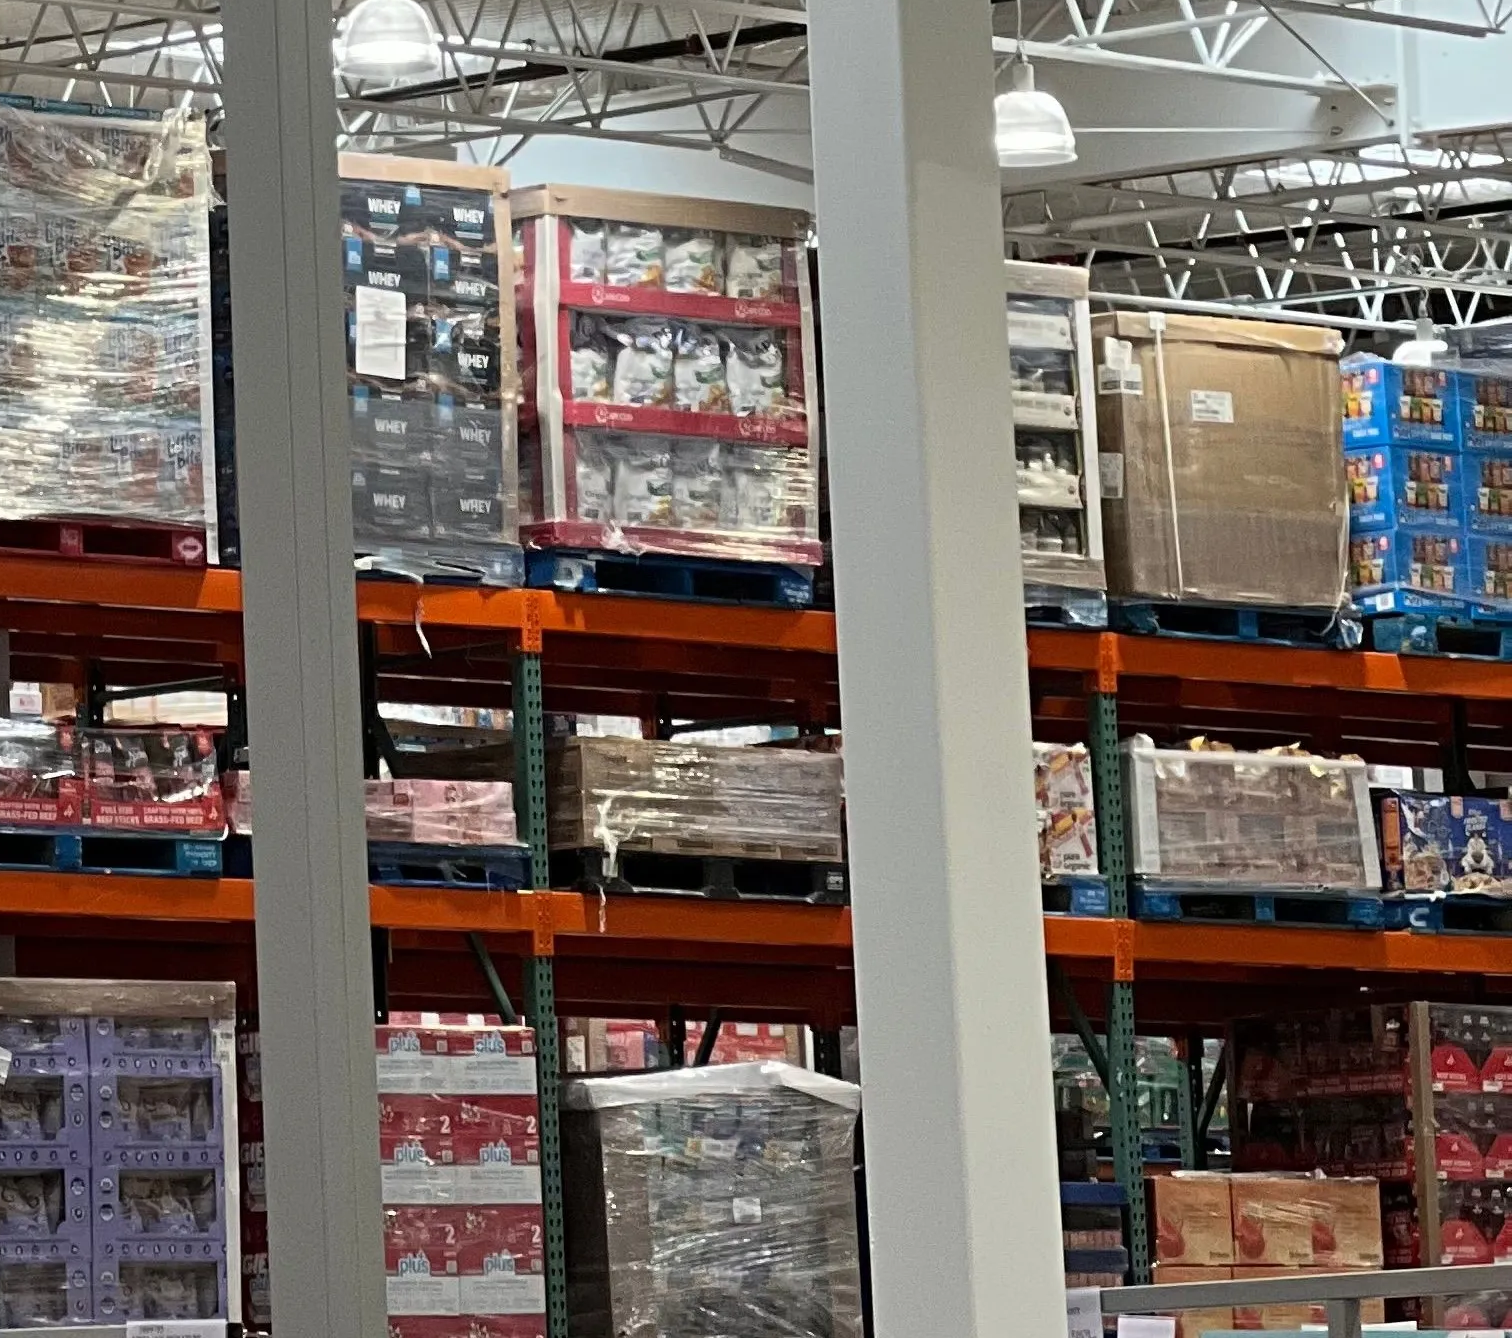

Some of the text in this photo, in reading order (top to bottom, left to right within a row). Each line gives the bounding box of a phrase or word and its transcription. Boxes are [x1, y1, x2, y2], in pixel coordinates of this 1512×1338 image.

[368, 198, 401, 215] WHEY
[452, 207, 485, 224] WHEY
[368, 270, 401, 287] WHEY
[455, 280, 487, 297] WHEY
[457, 352, 489, 369] WHEY
[374, 418, 408, 435] WHEY
[460, 426, 491, 444] WHEY
[373, 493, 406, 509] WHEY
[460, 498, 492, 514] WHEY
[143, 815, 185, 824] GRASS-FED
[390, 1034, 420, 1053] plus
[476, 1035, 505, 1054] plus
[440, 1115, 451, 1134] 2
[526, 1115, 537, 1134] 2
[396, 1146, 426, 1163] plus
[481, 1145, 510, 1163] plus
[445, 1226, 455, 1245] 2
[531, 1225, 542, 1244] 2
[400, 1258, 429, 1276] plus
[486, 1256, 515, 1273] plus
